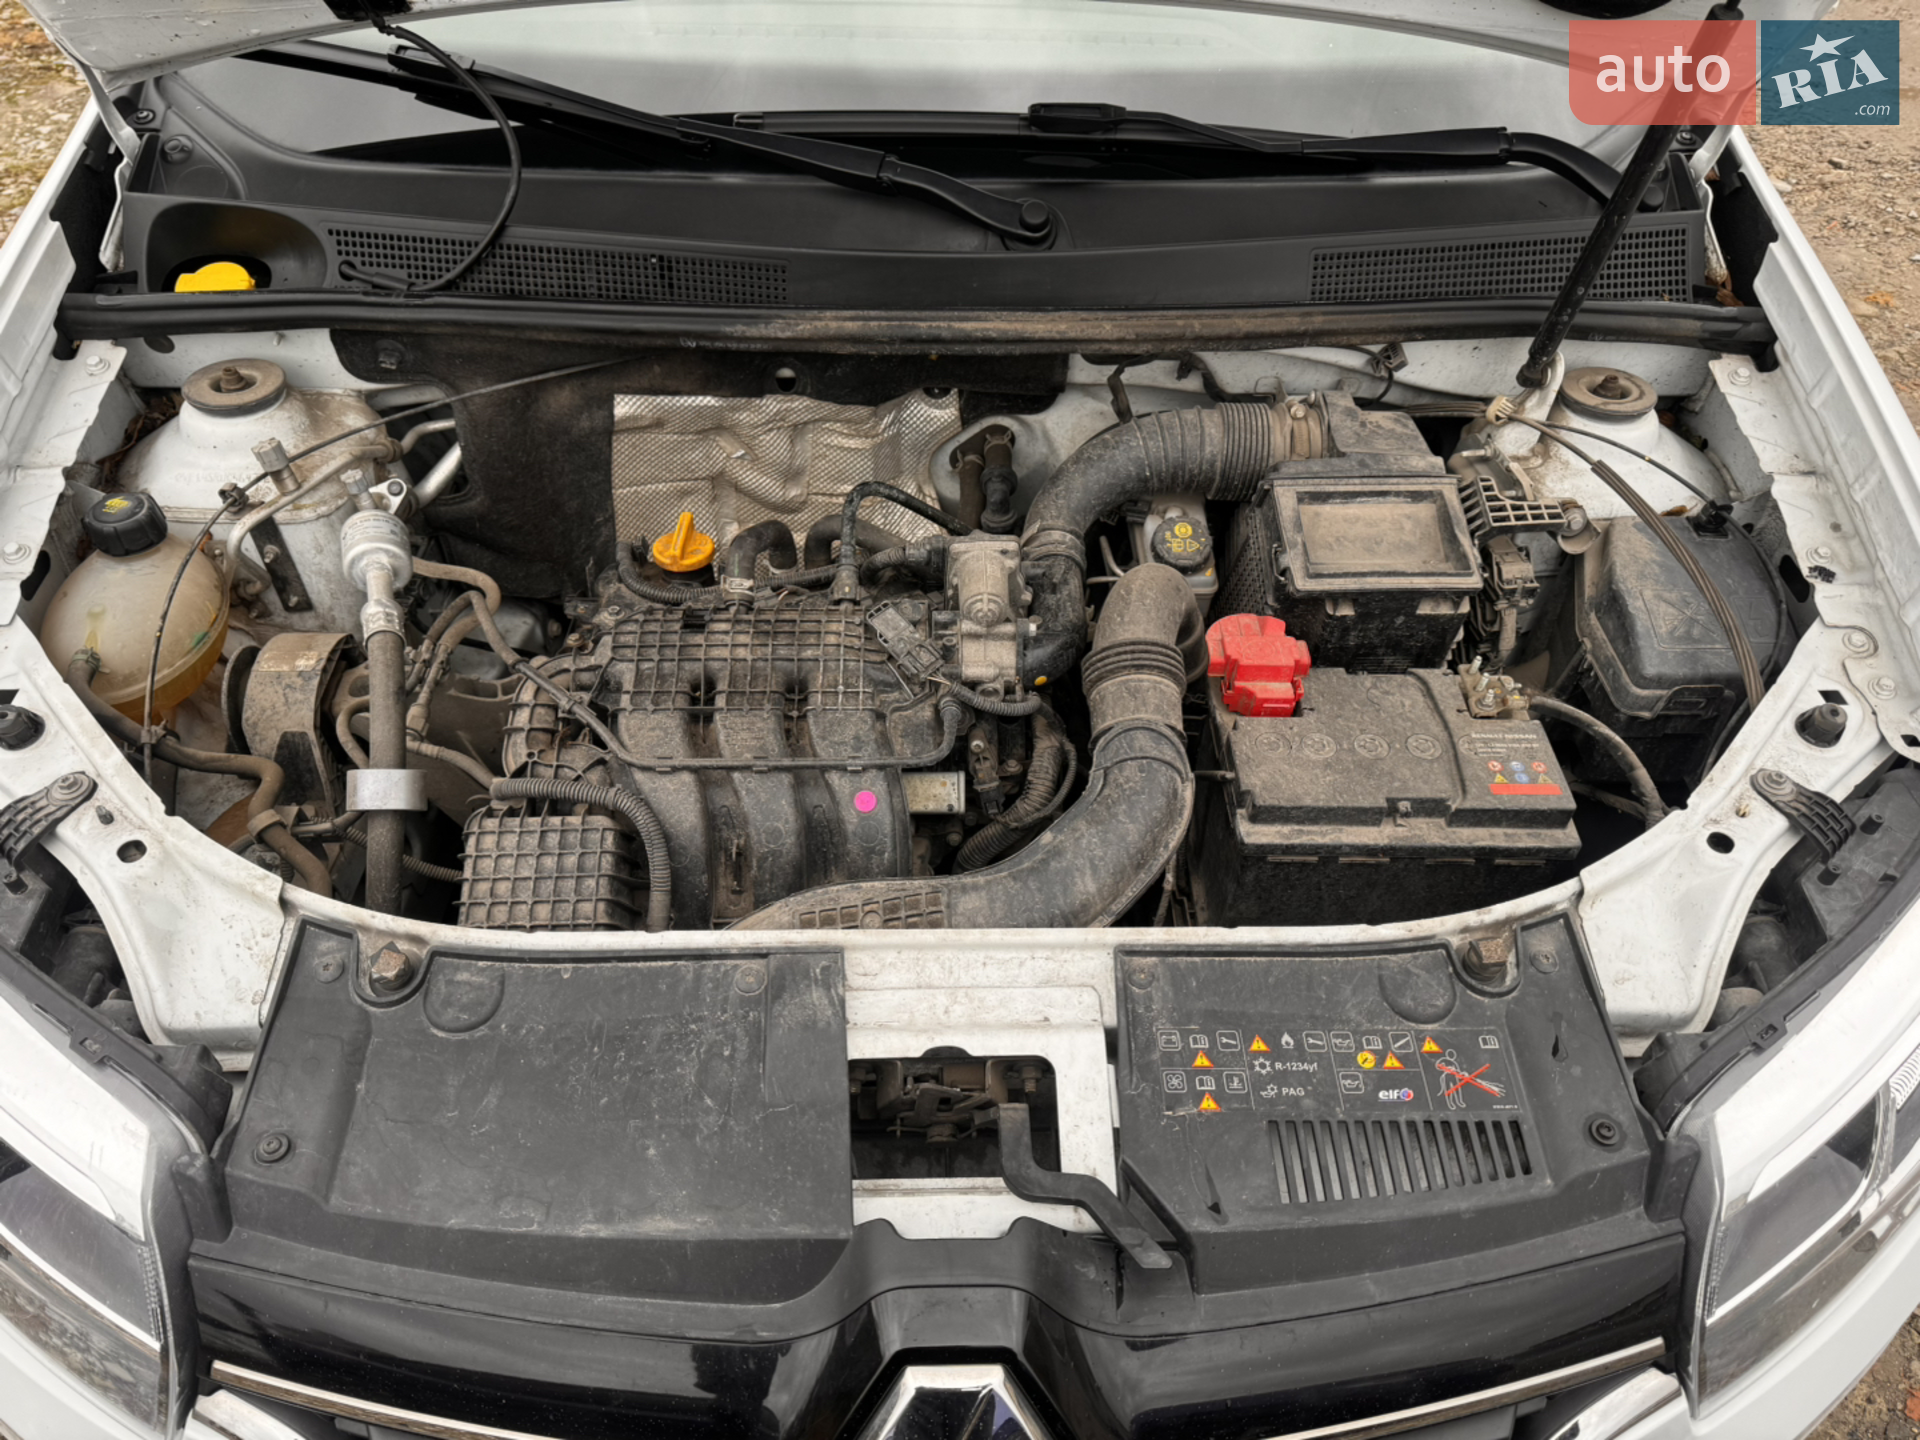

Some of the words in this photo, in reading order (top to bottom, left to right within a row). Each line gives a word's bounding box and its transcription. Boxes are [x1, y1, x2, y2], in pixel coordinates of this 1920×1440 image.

[1274, 1061, 1319, 1073] R-1234yf
[1281, 1087, 1305, 1097] PAG
[1378, 1089, 1400, 1100] elf
